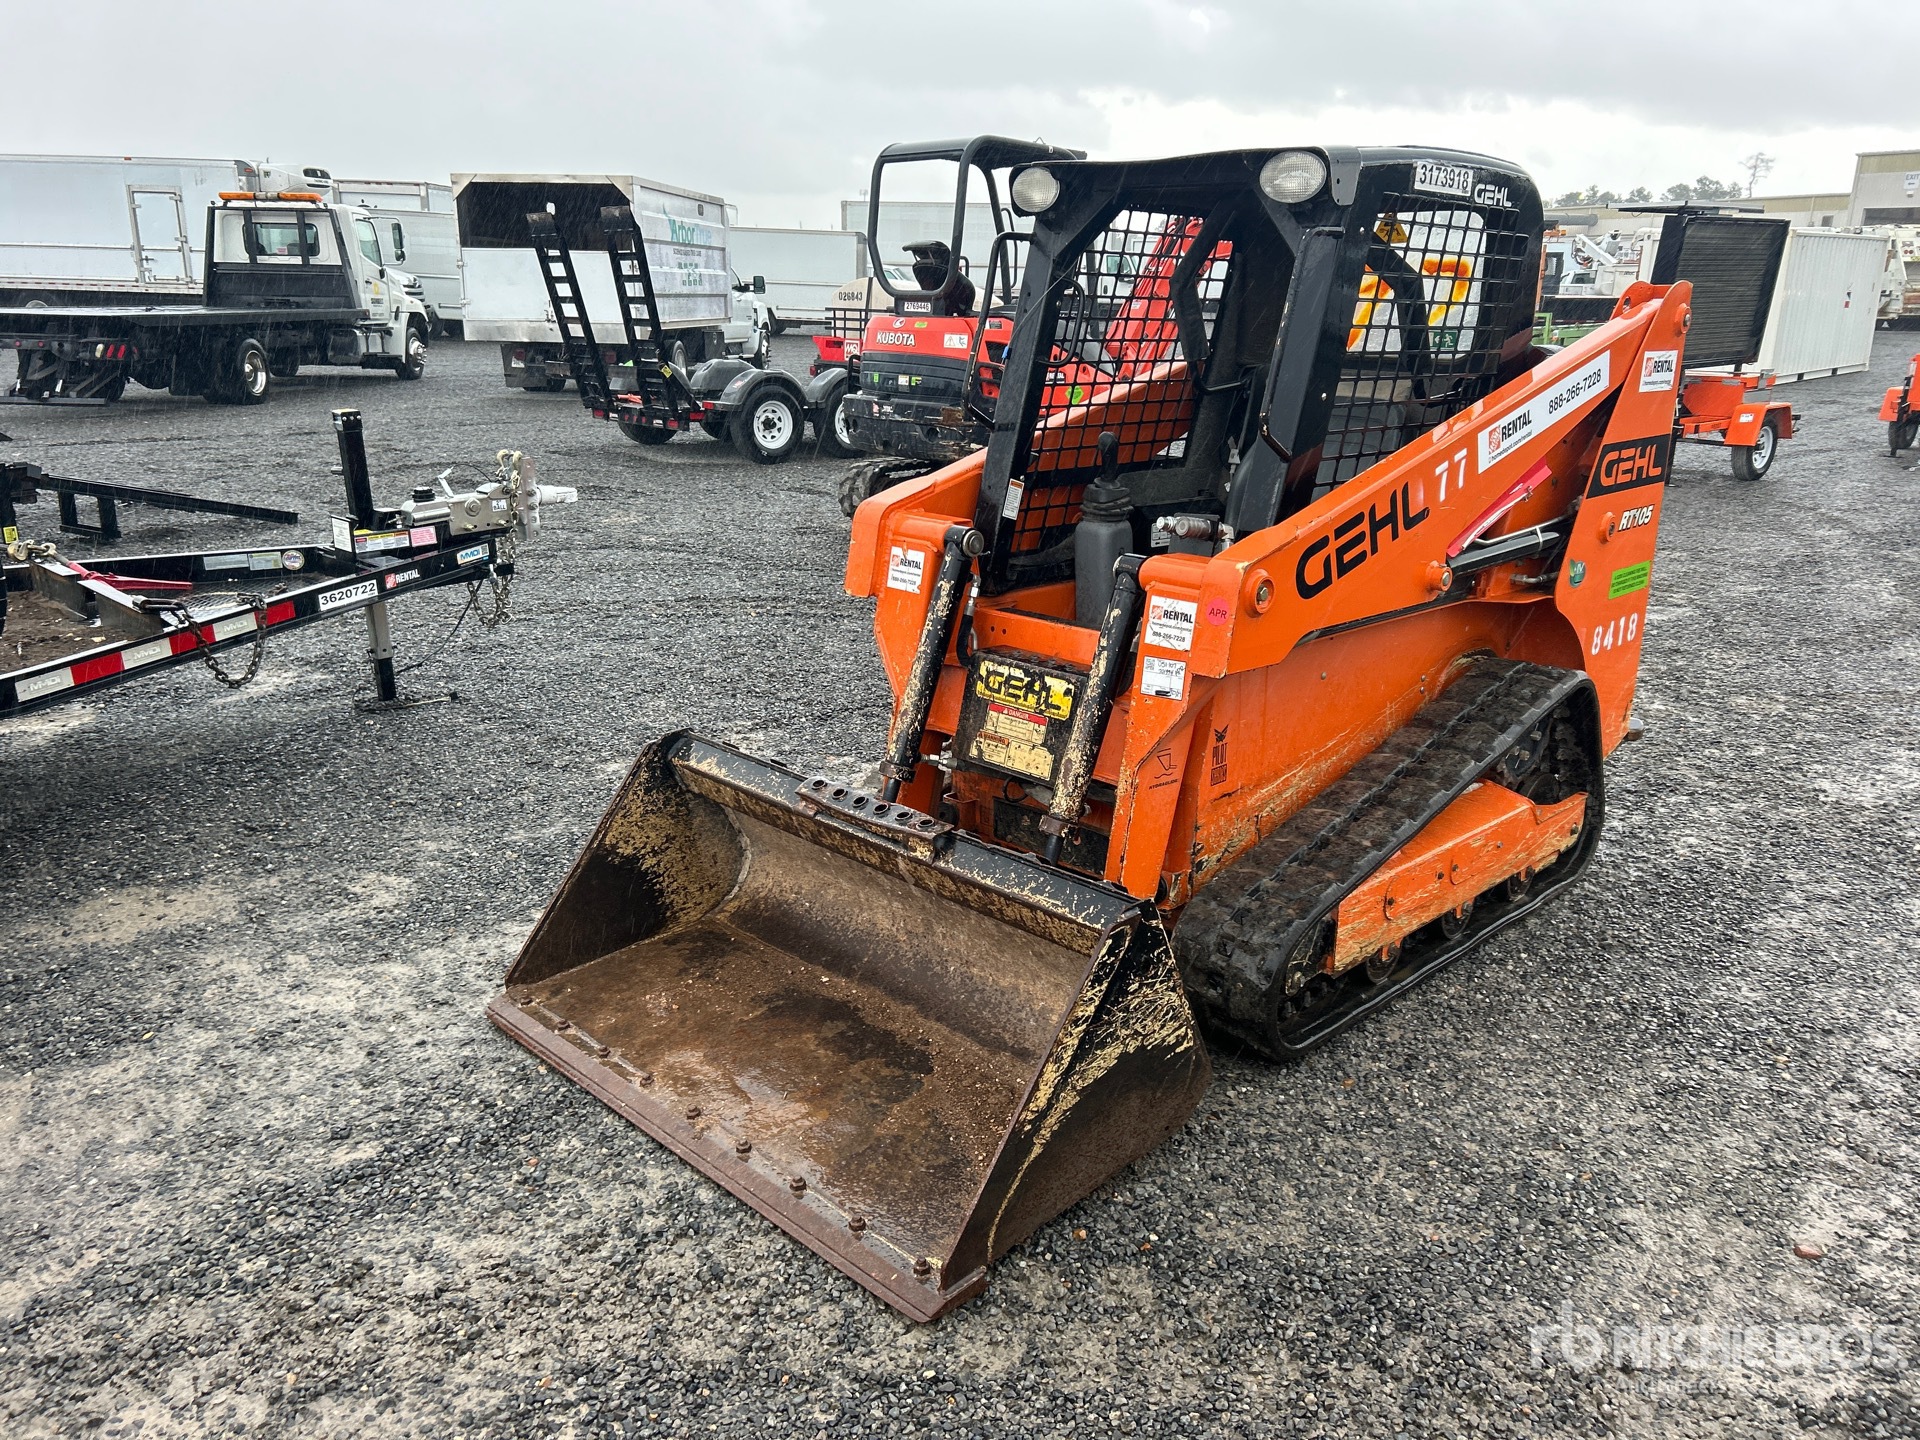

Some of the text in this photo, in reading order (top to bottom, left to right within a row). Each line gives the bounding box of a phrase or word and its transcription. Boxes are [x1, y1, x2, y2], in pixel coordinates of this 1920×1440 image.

[1420, 164, 1469, 190] 3173918
[1474, 183, 1512, 207] GEHL
[838, 291, 863, 301] 026843
[906, 302, 931, 311] 2769446
[876, 330, 916, 346] KUBOTA
[1653, 359, 1674, 374] RENTAL
[1548, 368, 1602, 415] 888-266-7228
[1501, 409, 1532, 442] RENTAL
[1435, 448, 1468, 502] 77
[1600, 444, 1662, 487] GEHL
[1618, 504, 1655, 532] RT105
[1296, 481, 1430, 600] GEHL
[900, 558, 921, 570] RENTAL
[395, 569, 420, 584] RENTAL
[320, 582, 376, 606] 3620722
[1163, 609, 1194, 624] RENTAL
[1208, 607, 1228, 620] APR
[1152, 631, 1186, 643] 888-266-7228
[1592, 612, 1638, 656] 8418
[1008, 709, 1029, 720] DANGER
[1212, 742, 1228, 767] PILOT
